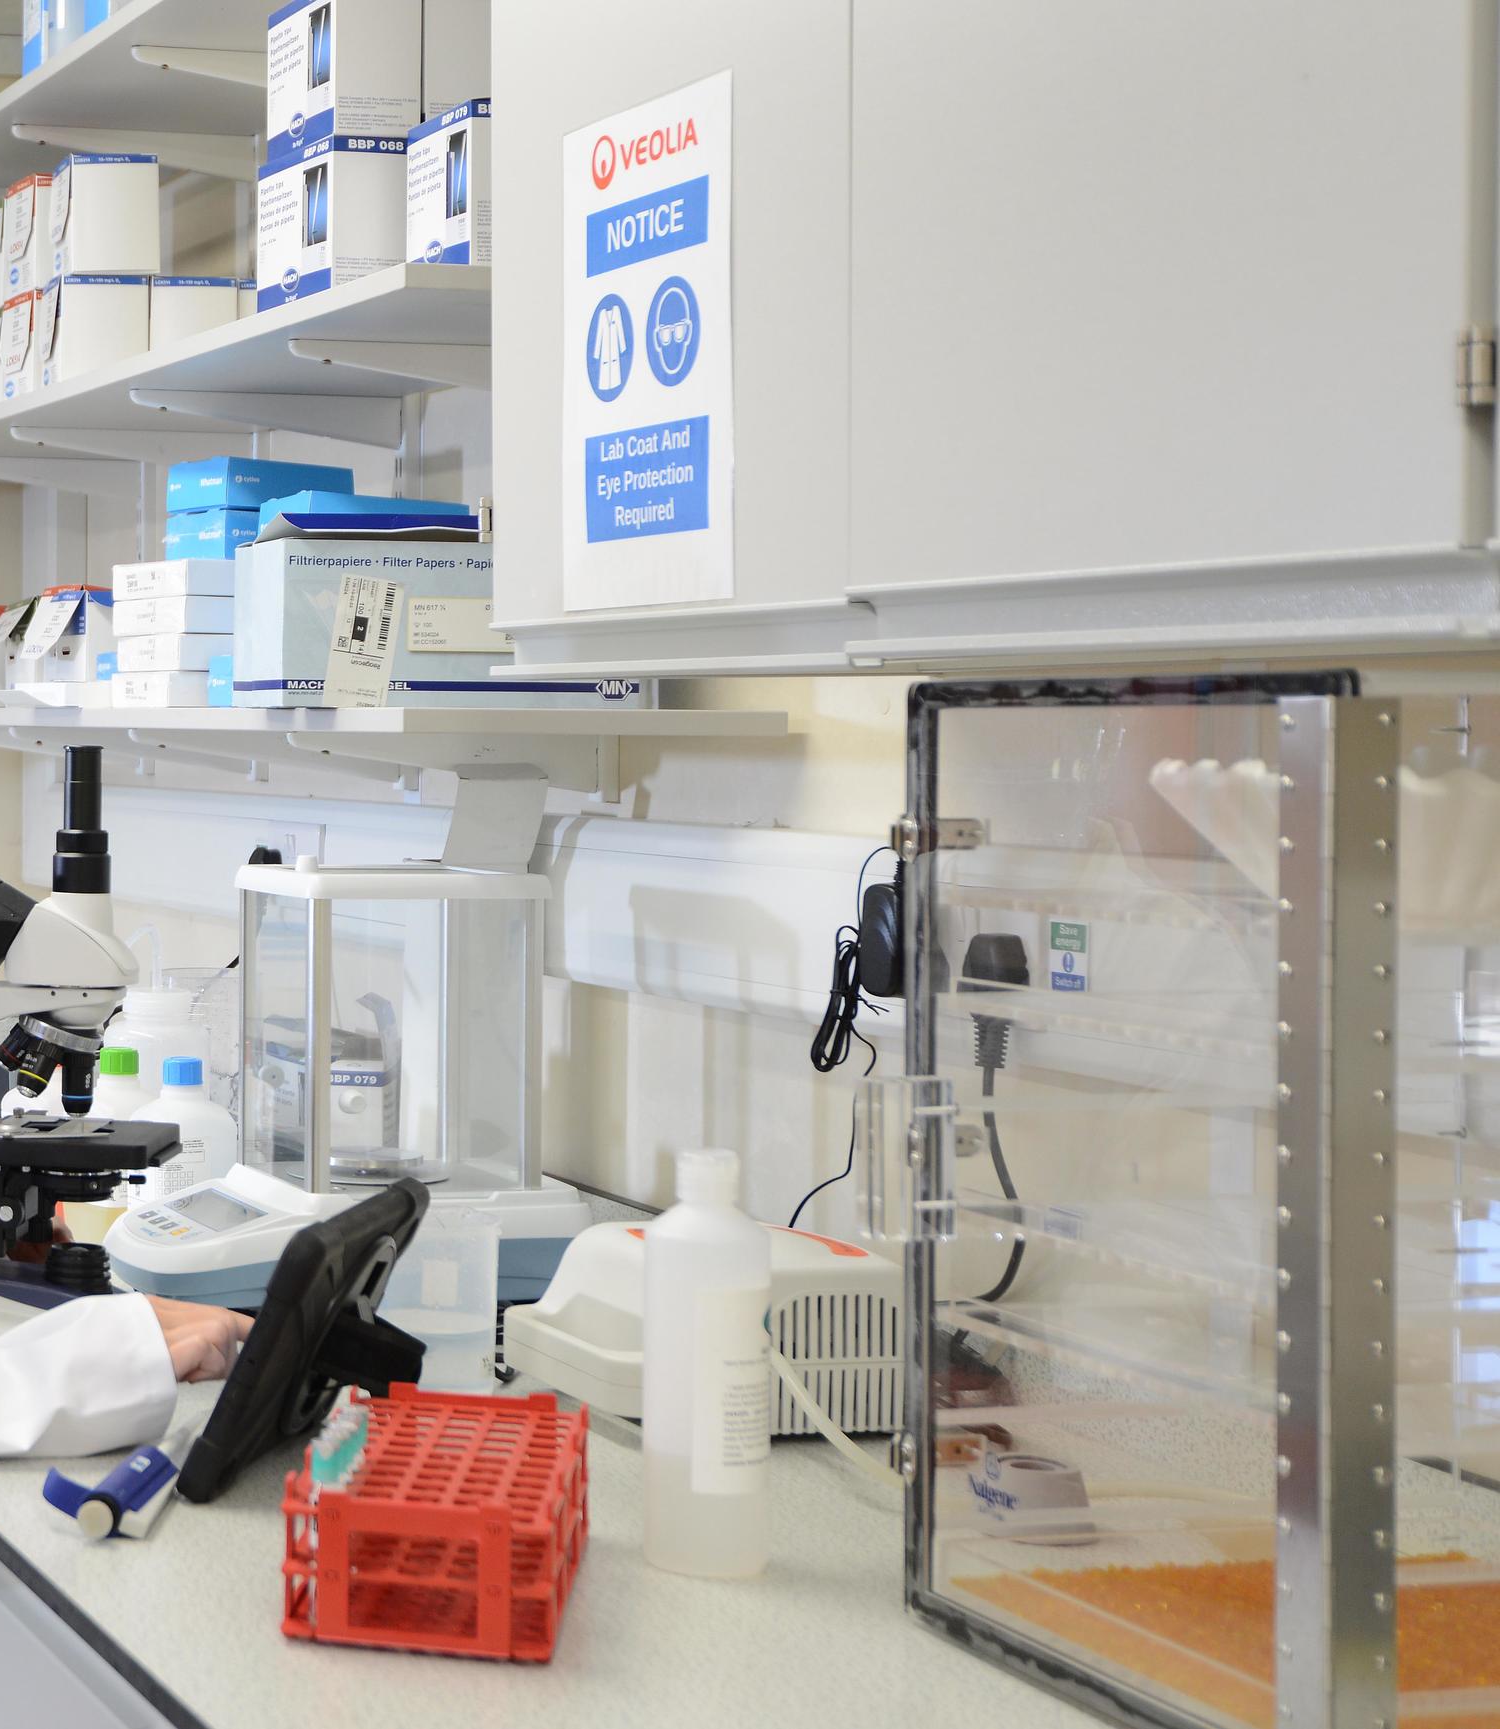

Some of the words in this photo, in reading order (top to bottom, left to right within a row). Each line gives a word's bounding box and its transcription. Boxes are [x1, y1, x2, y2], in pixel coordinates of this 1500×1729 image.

[441, 113, 455, 126] BBP
[455, 105, 468, 120] 079
[304, 144, 317, 159] BBP
[316, 140, 330, 154] 068
[348, 138, 376, 150] BBP
[379, 140, 405, 151] 068
[620, 118, 698, 170] VEOLIA
[606, 198, 684, 254] NOTICE
[425, 246, 442, 259] HACH
[283, 272, 298, 284] HACH
[600, 440, 624, 462] Lab
[627, 434, 658, 458] Coat
[661, 425, 690, 451] And
[597, 474, 621, 500] Eye
[624, 462, 694, 492] Protection
[614, 498, 675, 530] Required
[288, 555, 372, 569] Filtrierpapiere
[383, 556, 412, 568] Filter
[416, 557, 456, 570] Papers
[287, 680, 325, 689] MACH
[388, 681, 412, 690] GEL
[602, 680, 628, 696] MN
[1060, 924, 1078, 936] Save
[354, 1075, 377, 1085] 079
